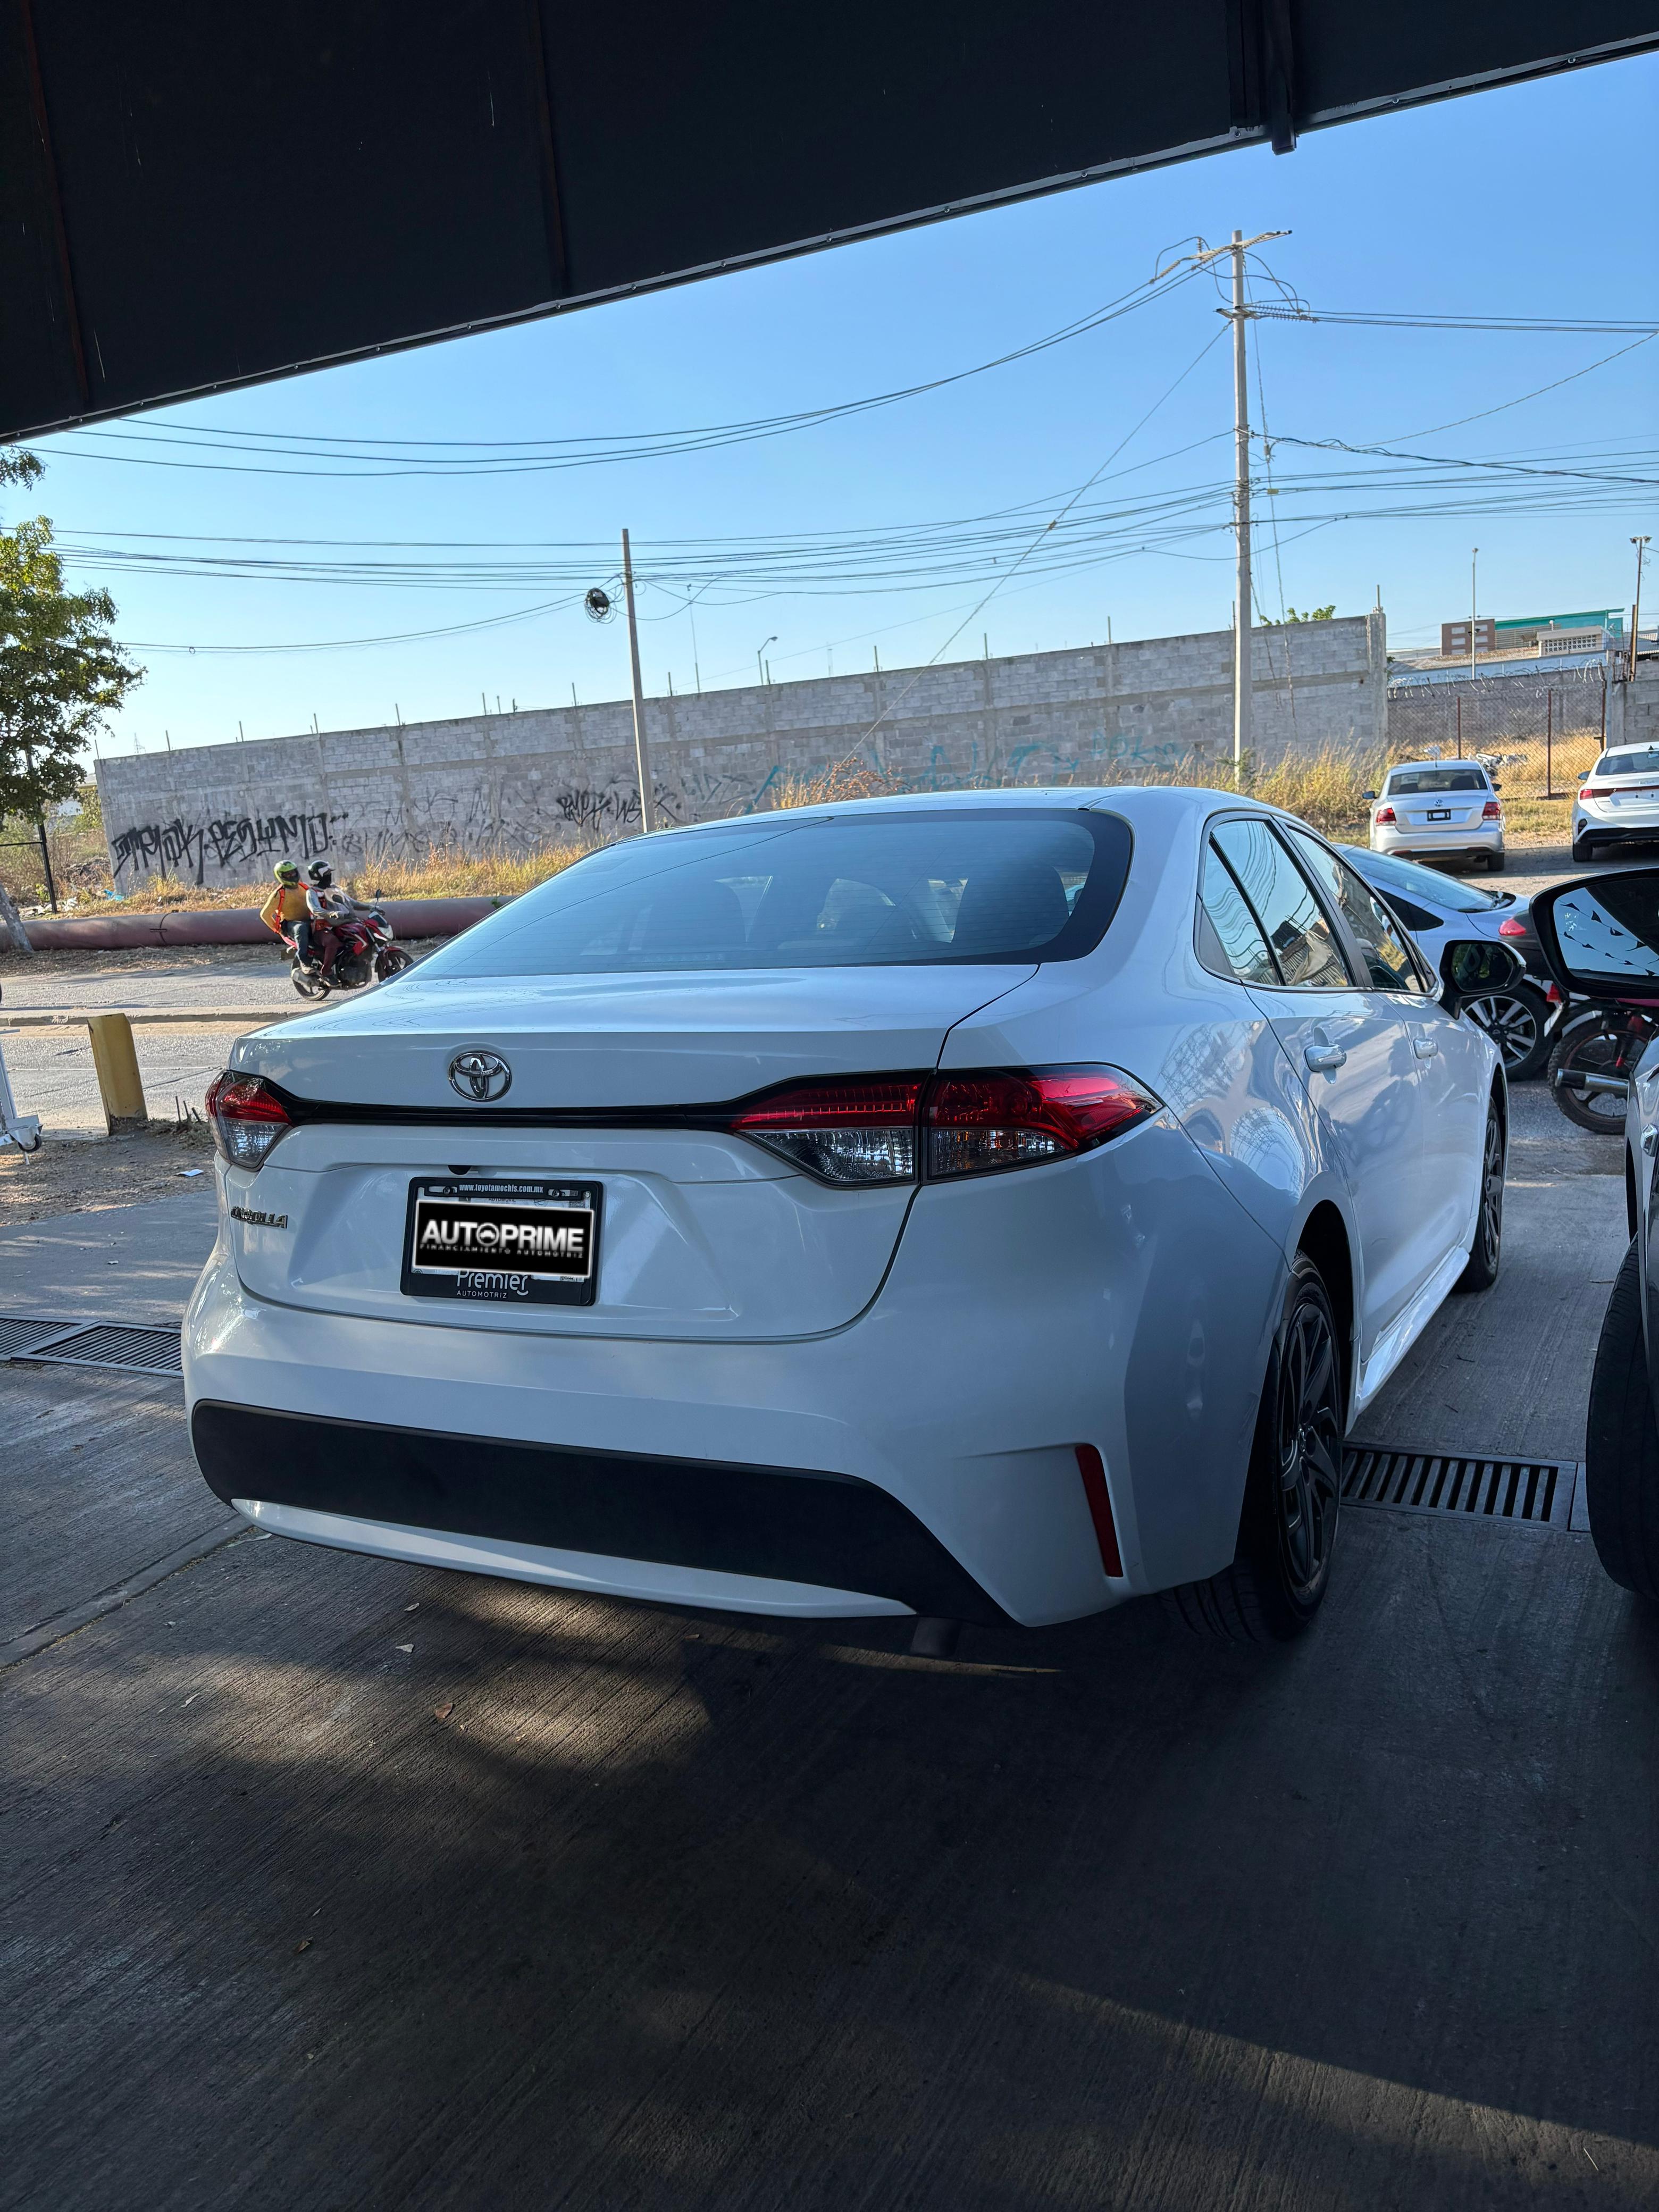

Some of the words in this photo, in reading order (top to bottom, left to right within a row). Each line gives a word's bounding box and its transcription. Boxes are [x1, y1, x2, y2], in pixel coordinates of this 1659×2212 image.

[459, 1184, 543, 1193] www.toyotamochis.com.mx
[456, 1270, 529, 1296] Premier
[456, 1290, 507, 1299] AUTOMOTRIZ
